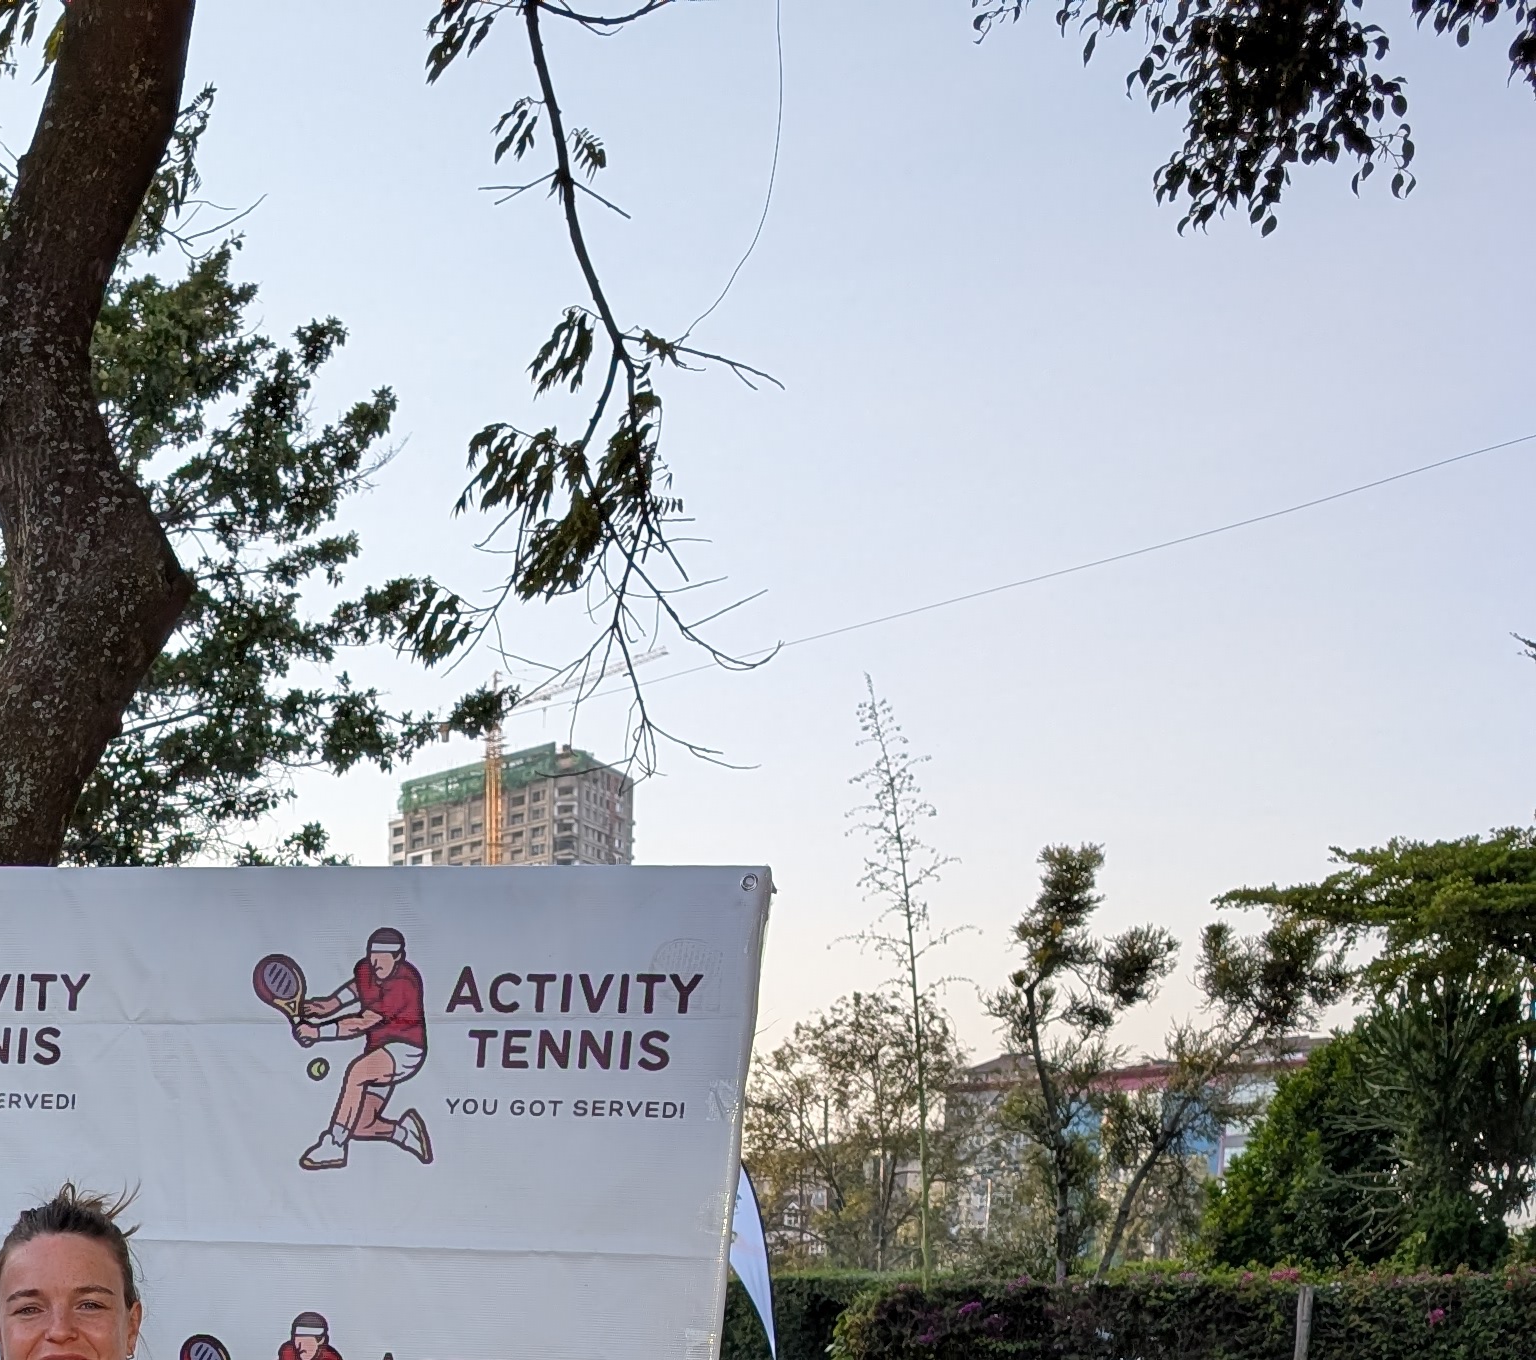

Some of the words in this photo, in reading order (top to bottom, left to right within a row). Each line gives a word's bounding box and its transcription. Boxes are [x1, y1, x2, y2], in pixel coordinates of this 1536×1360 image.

[445, 965, 705, 1015] ACTIVITY
[468, 1029, 671, 1072] TENNIS
[445, 1098, 498, 1116] YOU
[509, 1099, 564, 1117] GOT
[572, 1099, 685, 1119] SERVED!
